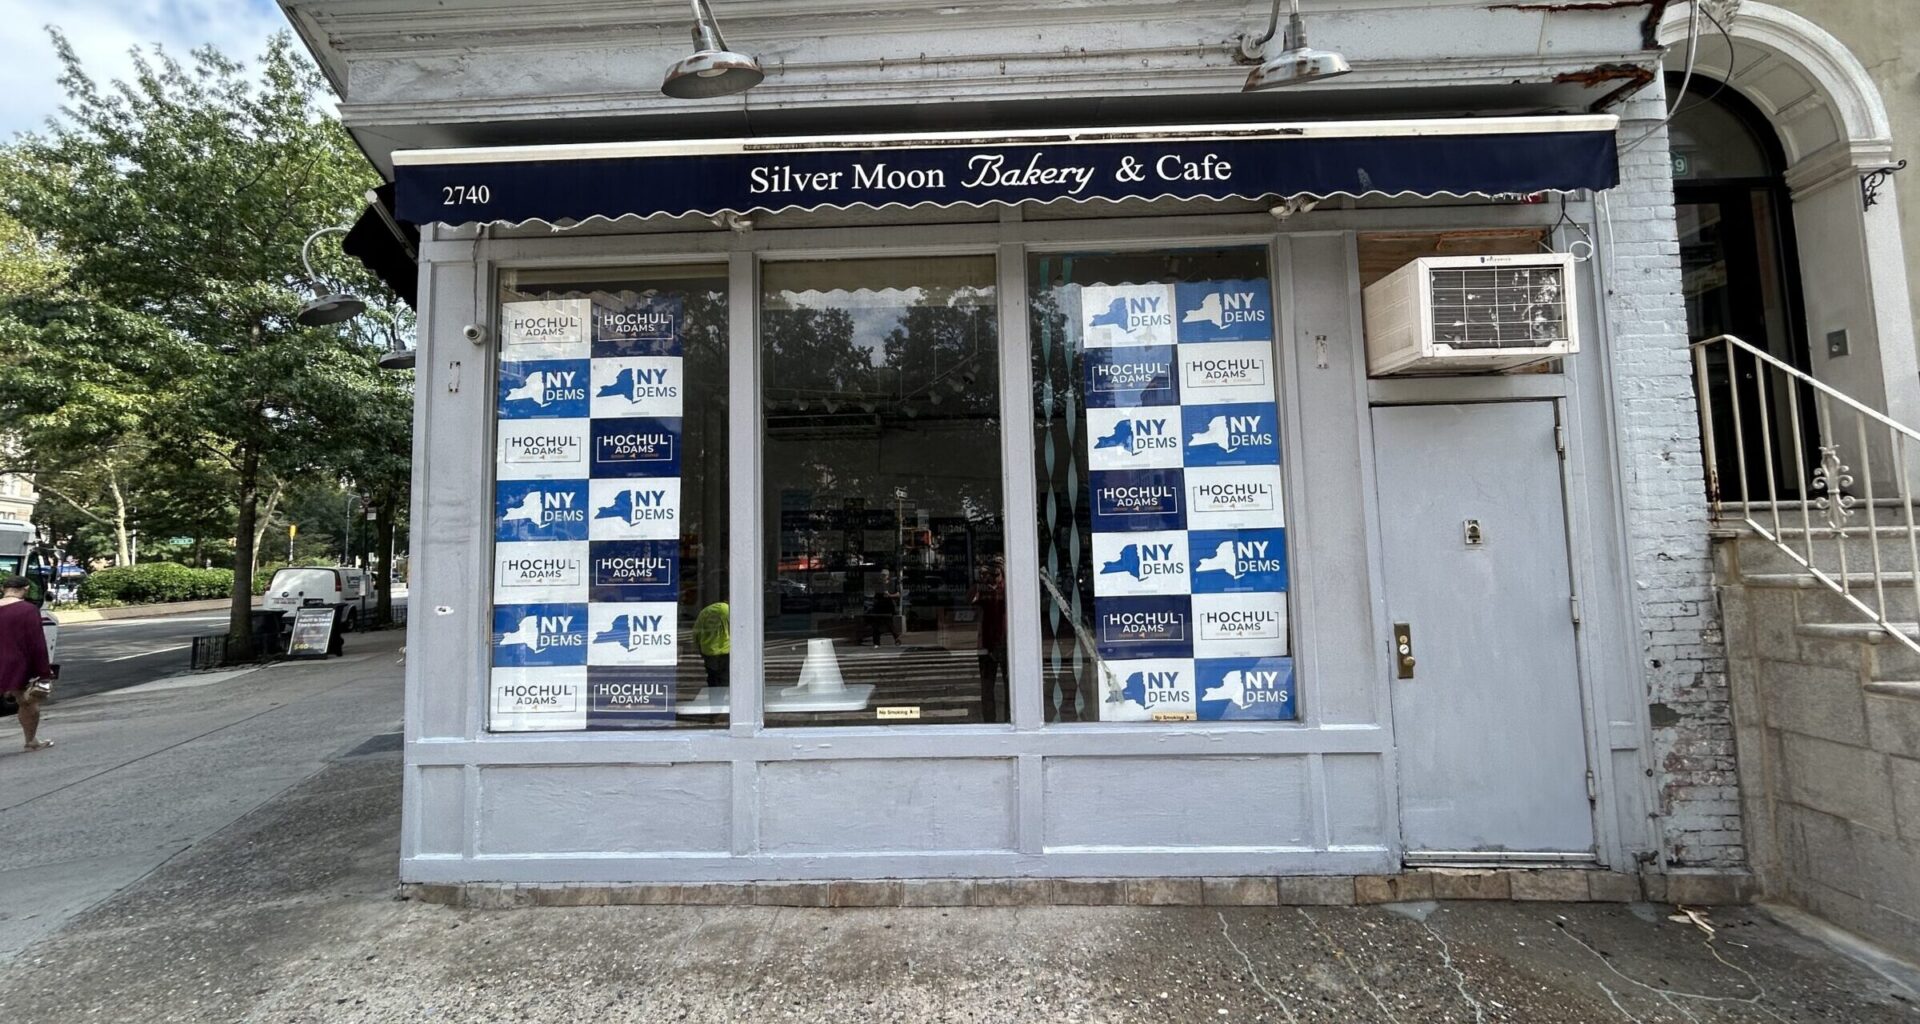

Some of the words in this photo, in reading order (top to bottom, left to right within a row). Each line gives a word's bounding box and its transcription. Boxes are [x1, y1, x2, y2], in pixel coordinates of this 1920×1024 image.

[749, 165, 843, 194] Silver
[851, 163, 946, 190] Moon
[960, 152, 1095, 195] Bakery
[1115, 155, 1146, 183] &
[1156, 153, 1232, 181] Cafe
[442, 185, 490, 205] 2740
[1130, 297, 1160, 313] NY
[1224, 293, 1255, 309] NY
[604, 314, 669, 326] HOCHUL
[1131, 314, 1171, 327] DEMS
[1225, 310, 1264, 323] DEMS
[514, 317, 578, 329] HOCHUL
[615, 324, 655, 333] ADAMS
[526, 328, 564, 336] ADAMS
[1098, 363, 1165, 376] HOCHUL
[1192, 359, 1259, 371] HOCHUL
[547, 371, 576, 388] NY
[637, 369, 667, 384] NY
[1111, 374, 1151, 383] ADAMS
[1205, 370, 1246, 379] ADAMS
[547, 389, 584, 401] DEMS
[637, 386, 677, 398] DEMS
[1136, 419, 1166, 436] NY
[1230, 416, 1261, 432] NY
[512, 436, 577, 447] HOCHUL
[603, 434, 668, 446] HOCHUL
[1137, 437, 1177, 449] DEMS
[1232, 434, 1272, 446] DEMS
[524, 447, 563, 455] ADAMS
[615, 445, 654, 454] ADAMS
[1104, 486, 1172, 499] HOCHUL
[1200, 484, 1267, 495] HOCHUL
[545, 492, 575, 508] NY
[635, 490, 665, 506] NY
[1117, 498, 1158, 507] ADAMS
[1213, 495, 1254, 503] ADAMS
[545, 510, 583, 521] DEMS
[635, 508, 673, 520] DEMS
[1142, 544, 1173, 560] NY
[1237, 541, 1269, 558] NY
[508, 559, 575, 570] HOCHUL
[602, 558, 666, 569] HOCHUL
[1143, 563, 1184, 574] DEMS
[1239, 560, 1280, 572] DEMS
[520, 570, 561, 578] ADAMS
[613, 569, 652, 577] ADAMS
[1110, 613, 1178, 624] HOCHUL
[1207, 611, 1274, 623] HOCHUL
[541, 616, 573, 633] NY
[633, 616, 662, 631] NY
[1123, 623, 1164, 632] ADAMS
[1220, 622, 1261, 631] ADAMS
[541, 635, 581, 647] DEMS
[633, 634, 671, 645] DEMS
[1148, 672, 1179, 688] NY
[1246, 672, 1277, 688] NY
[505, 685, 572, 696] HOCHUL
[600, 684, 663, 695] HOCHUL
[516, 696, 557, 705] ADAMS
[611, 695, 650, 703] ADAMS
[1148, 691, 1189, 702] DEMS
[1247, 691, 1288, 703] DEMS
